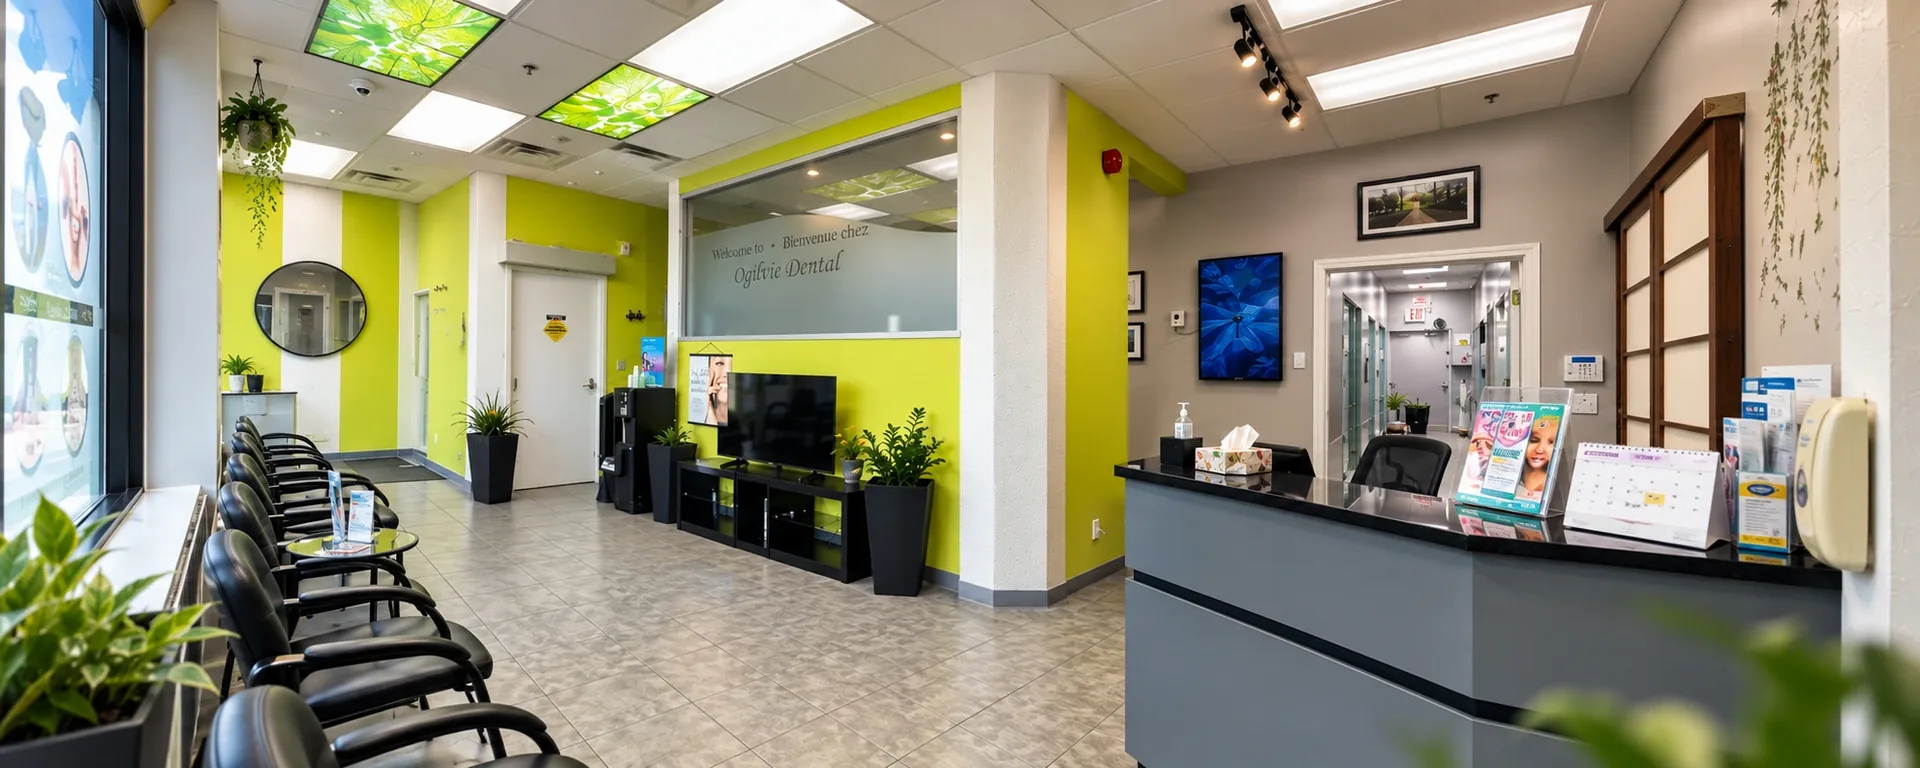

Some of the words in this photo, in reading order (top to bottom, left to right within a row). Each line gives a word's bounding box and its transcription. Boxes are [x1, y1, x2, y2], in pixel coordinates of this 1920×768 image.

[712, 246, 752, 260] Welcome
[754, 244, 764, 254] to
[782, 230, 838, 249] Bienvenue
[840, 224, 869, 240] chez
[734, 261, 781, 289] Ogilvie
[785, 250, 844, 277] Dental
